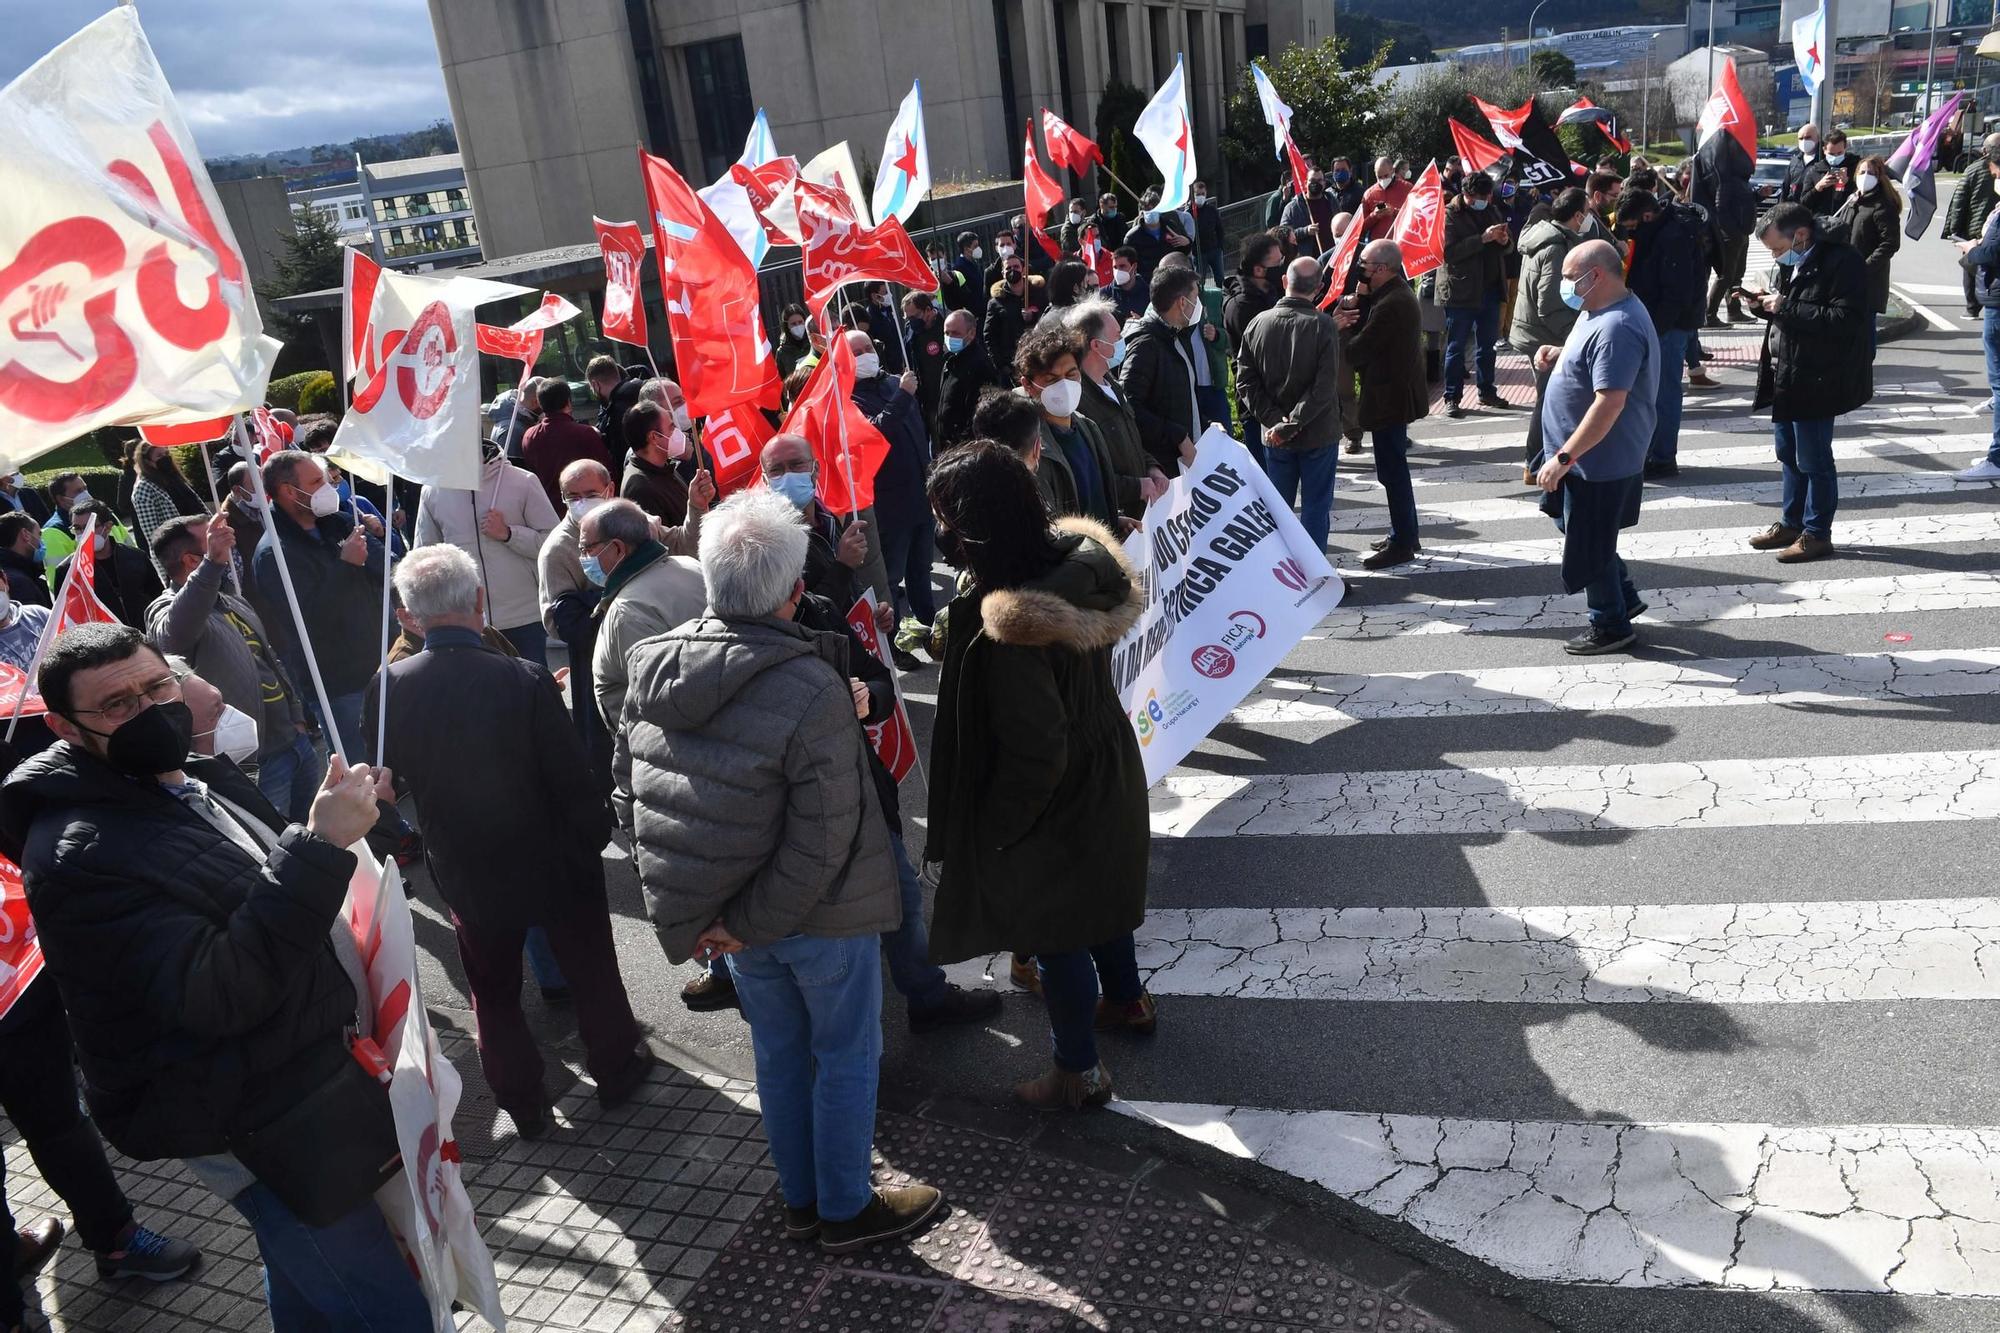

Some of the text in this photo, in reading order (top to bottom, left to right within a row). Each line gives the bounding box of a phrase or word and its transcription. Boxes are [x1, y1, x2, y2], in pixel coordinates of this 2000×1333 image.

[1567, 29, 1622, 41] LEROY MERLIN
[1202, 462, 1247, 497] DE
[1210, 497, 1278, 561] GALEG
[1221, 623, 1247, 646] FICA
[1194, 646, 1224, 670] UGT
[1162, 713, 1179, 730] Grupo
